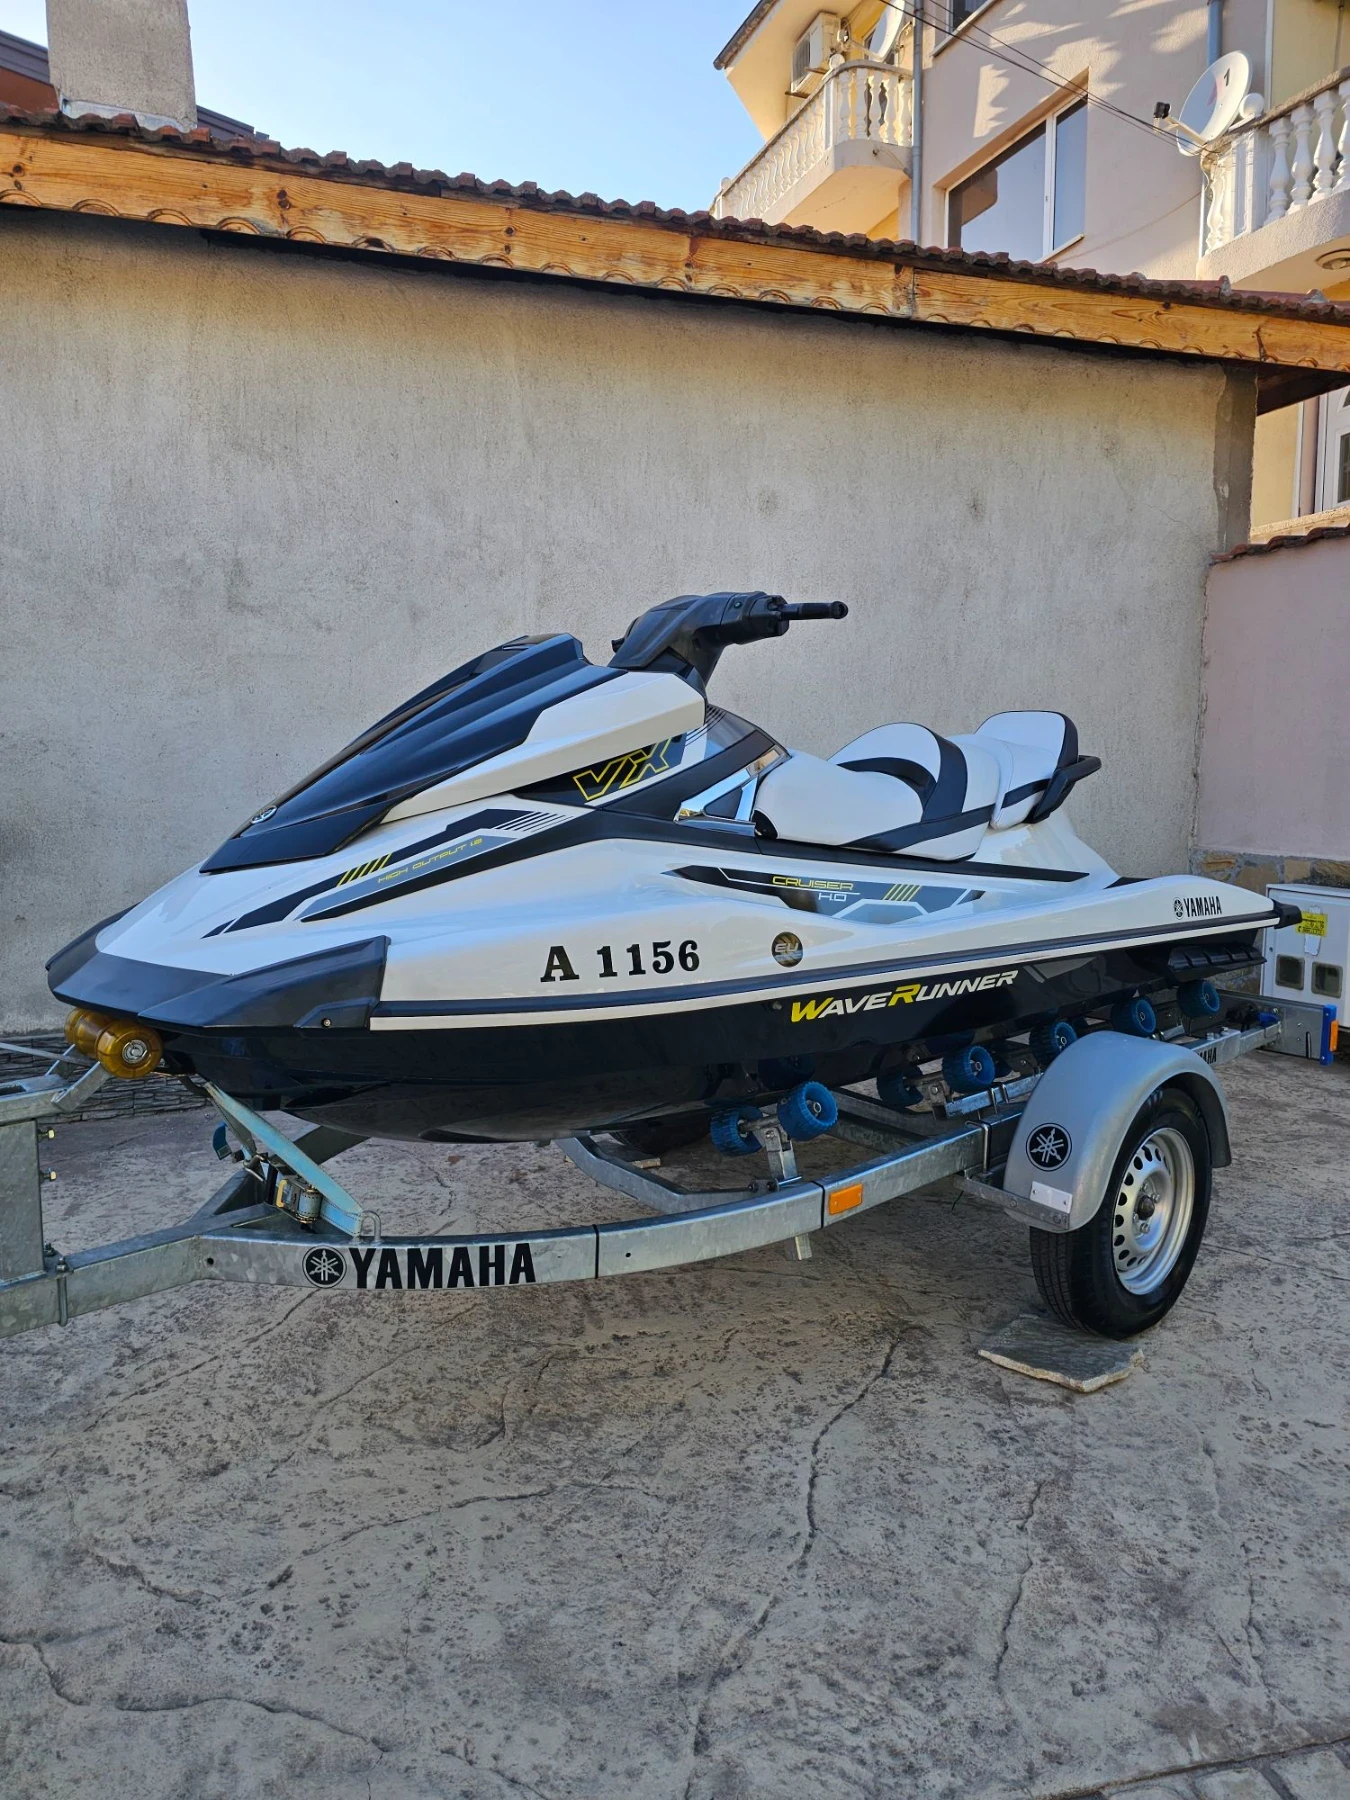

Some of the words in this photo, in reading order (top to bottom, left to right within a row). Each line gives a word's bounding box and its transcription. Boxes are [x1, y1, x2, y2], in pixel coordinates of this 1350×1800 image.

[572, 737, 670, 801] VX
[377, 867, 409, 884] HIGH
[412, 843, 467, 870] OUTPUT
[772, 875, 854, 891] CRUISER
[1183, 896, 1222, 918] YAMAHA
[540, 945, 580, 983] A
[596, 939, 700, 978] 1156
[348, 1242, 537, 1290] YAMAHA
